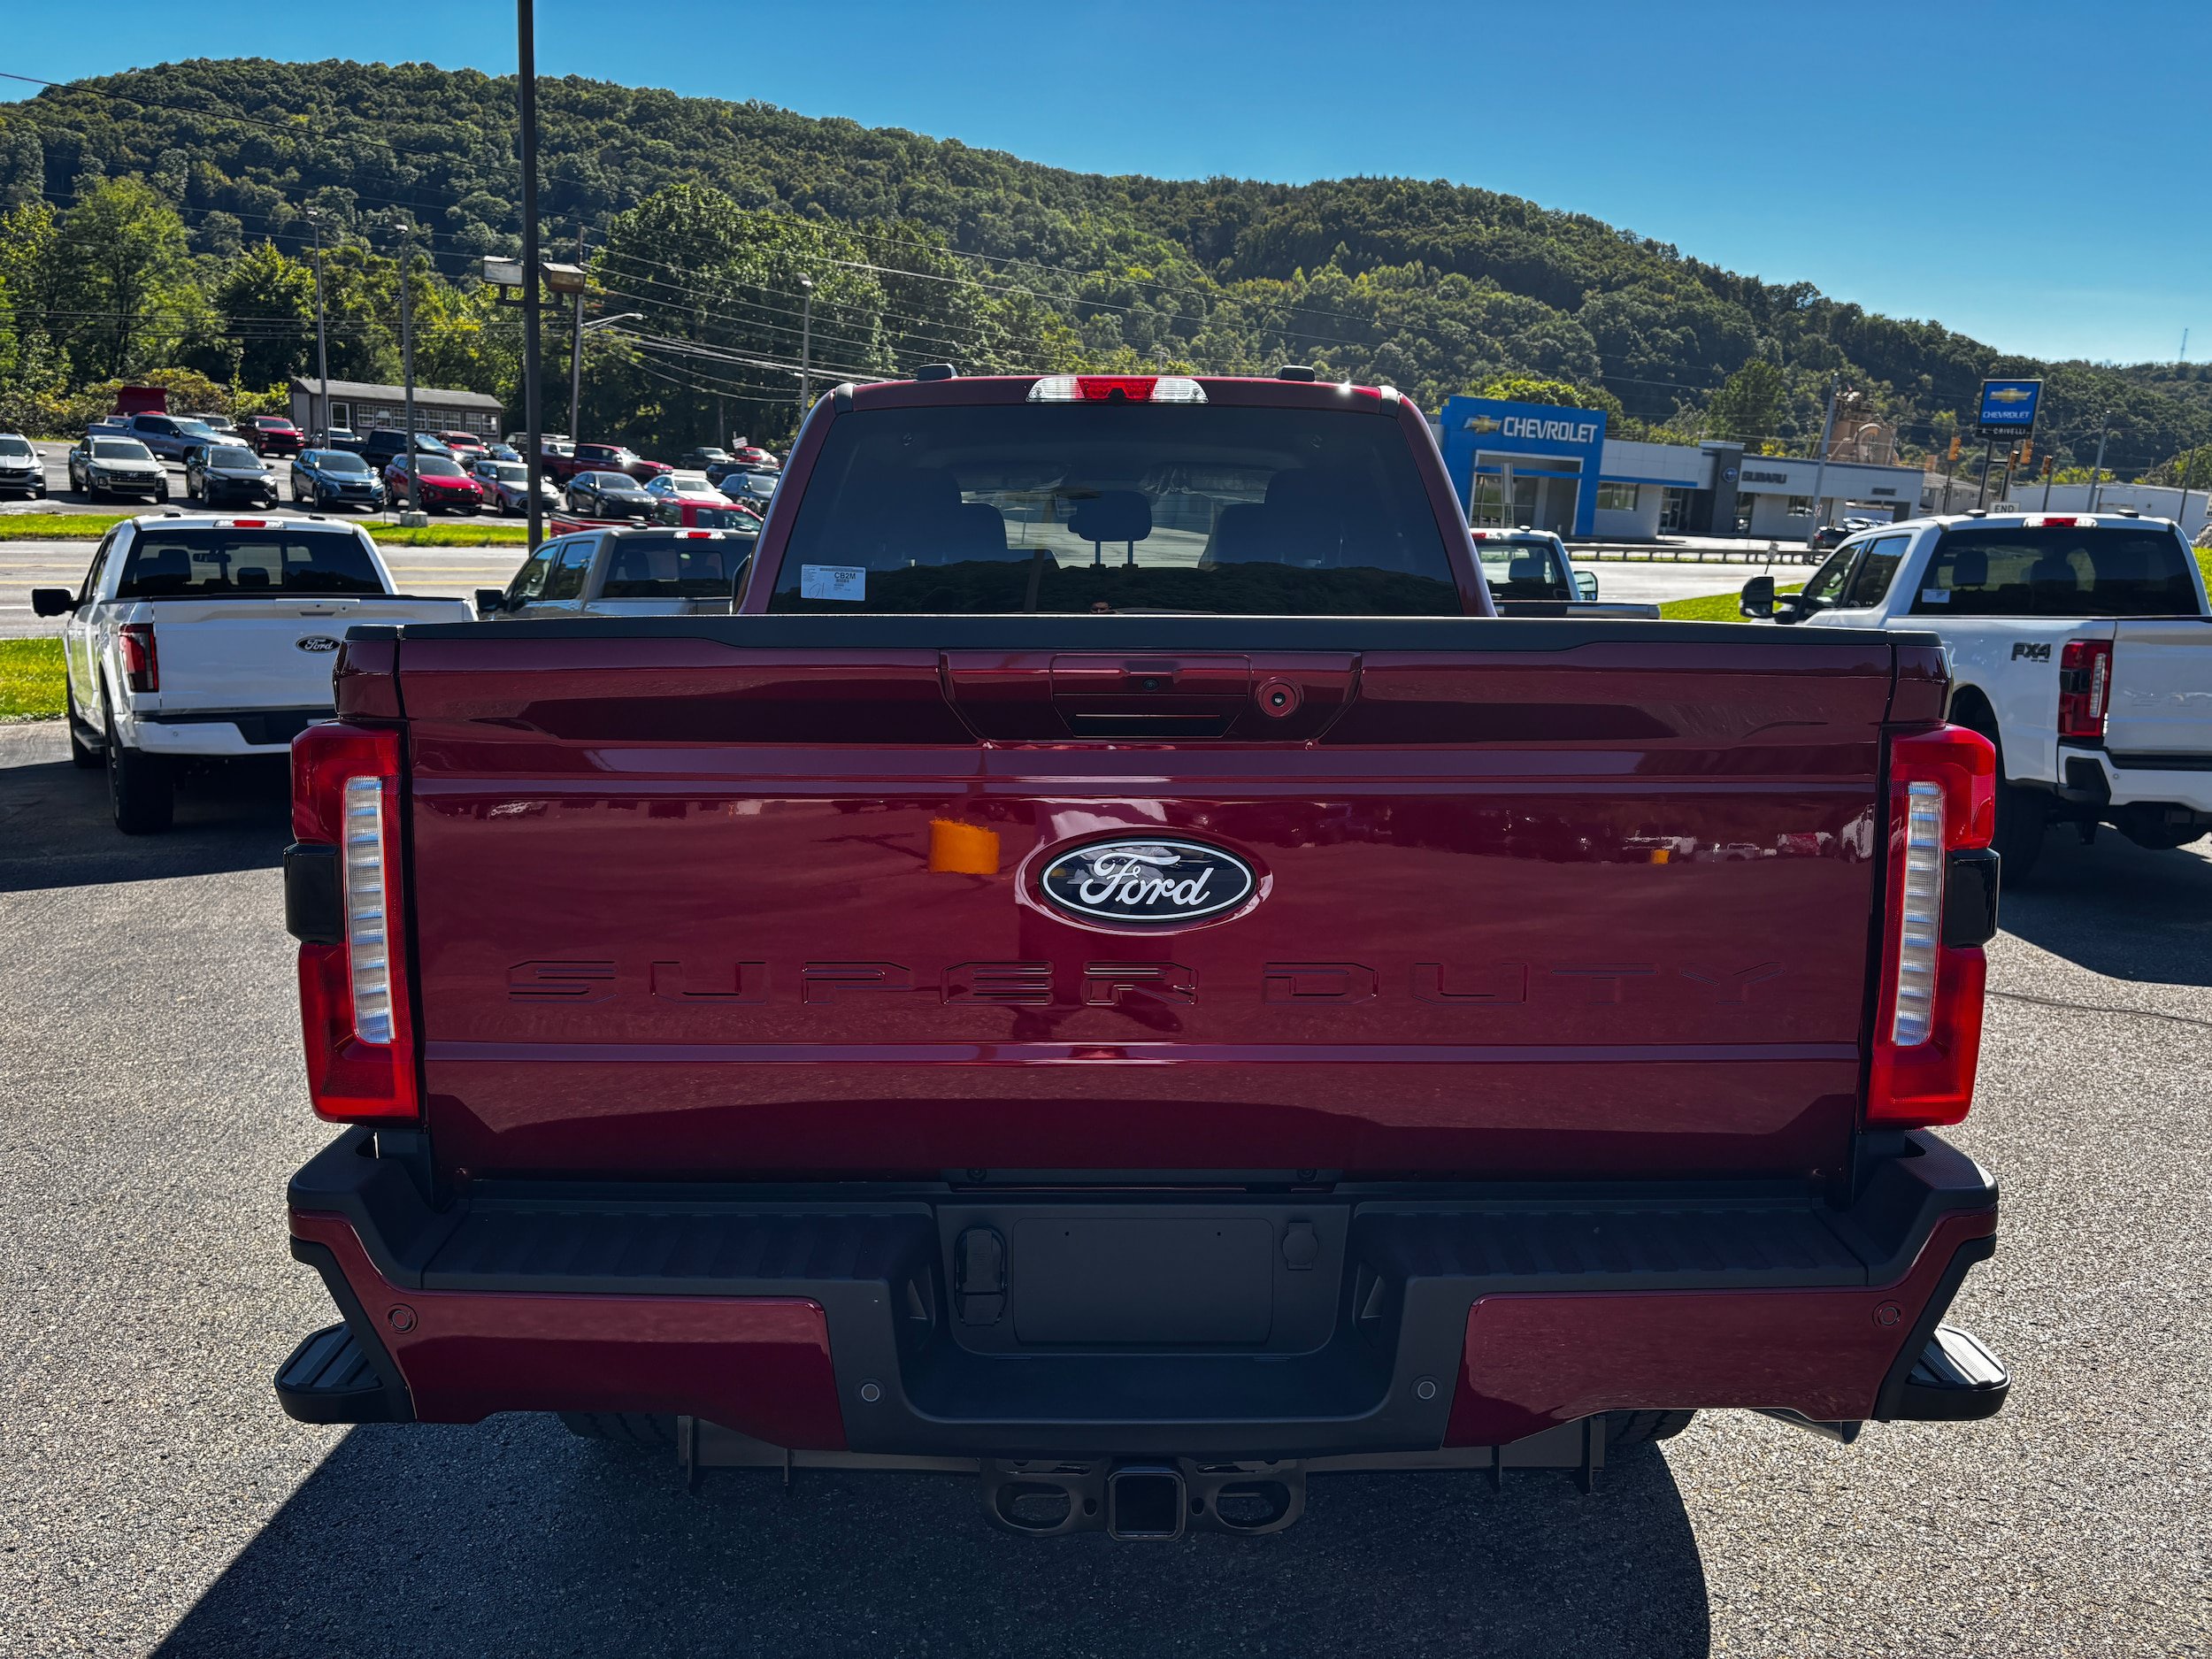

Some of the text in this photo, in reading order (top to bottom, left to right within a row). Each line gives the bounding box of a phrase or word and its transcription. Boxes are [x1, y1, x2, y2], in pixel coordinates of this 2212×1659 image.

[1982, 411, 2030, 419] CHEVROLET
[1503, 416, 1598, 443] CHEVROLET
[1741, 471, 1786, 484] SUBARU
[1994, 504, 2015, 513] END
[304, 638, 334, 650] Ford
[2011, 642, 2051, 660] FX4
[1079, 852, 1215, 906] Ford
[507, 960, 1786, 1006] SUPER DUTY
